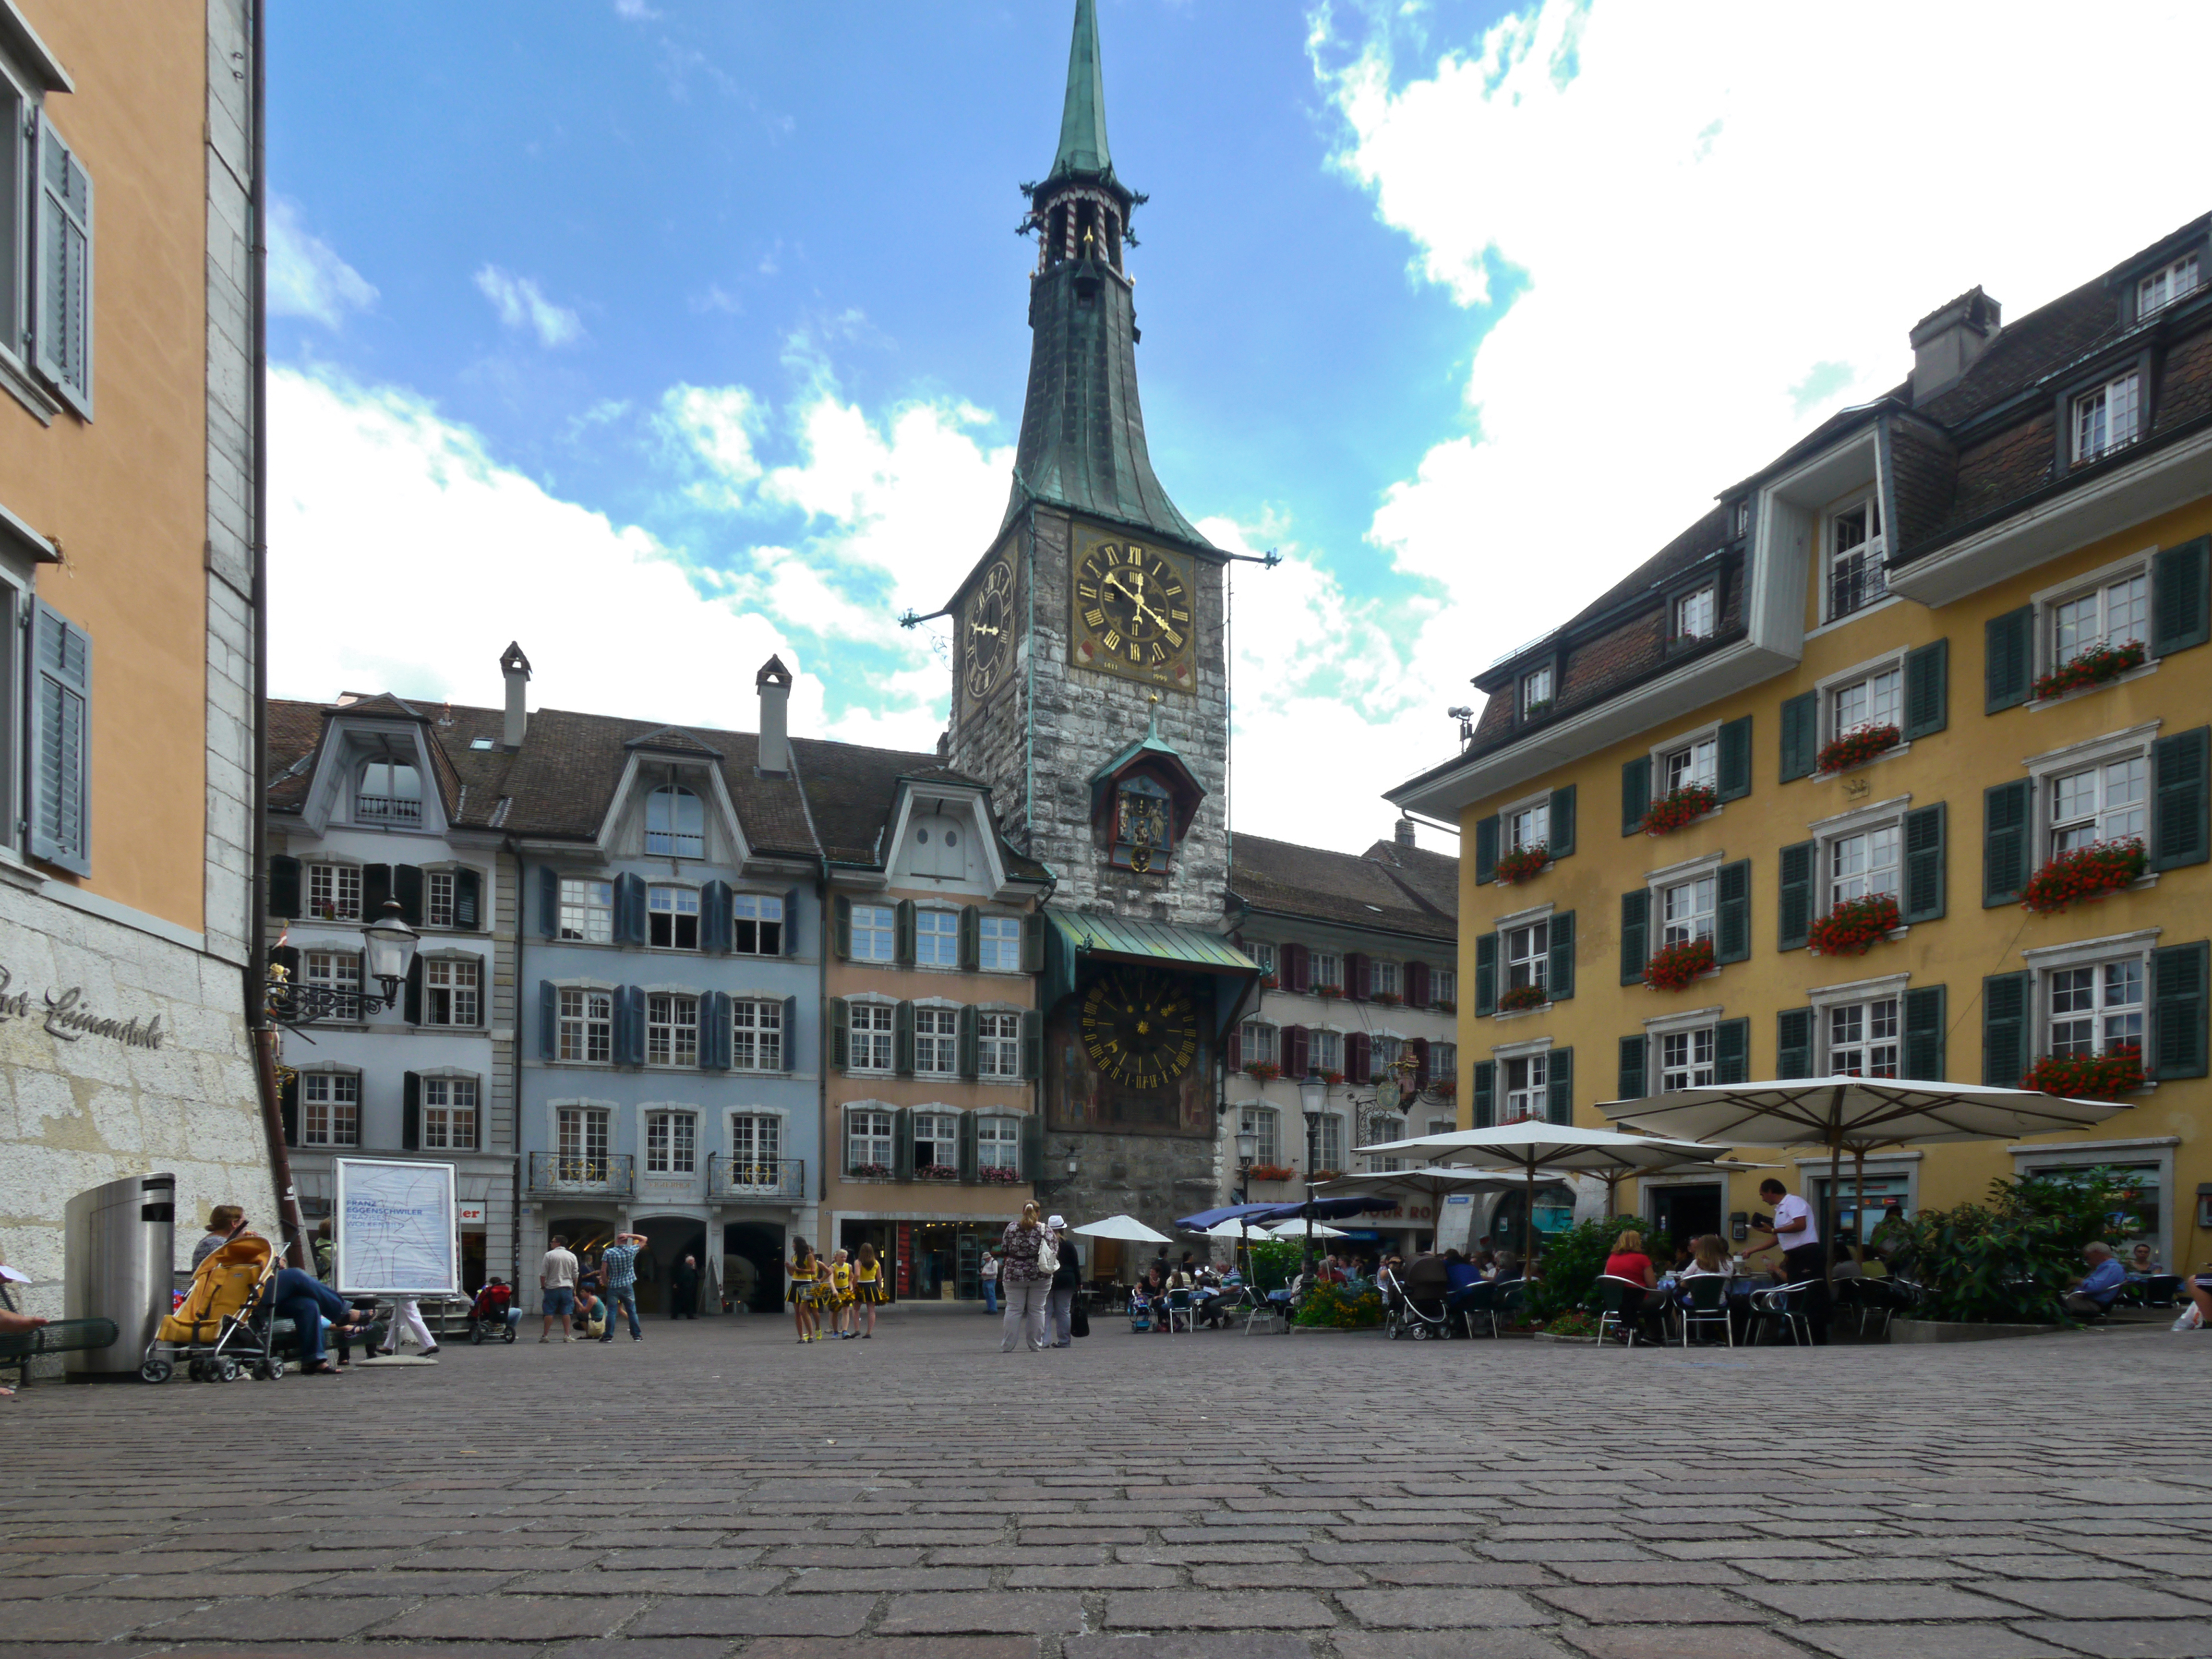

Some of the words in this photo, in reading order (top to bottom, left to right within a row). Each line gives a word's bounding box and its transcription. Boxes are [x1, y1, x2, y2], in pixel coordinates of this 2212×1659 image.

[1105, 546, 1119, 566] XI
[1128, 546, 1141, 566] XII
[1087, 560, 1102, 579] X
[1166, 586, 1182, 596] II
[347, 1207, 423, 1215] EGGENSCHWILER
[838, 1272, 845, 1280] R
